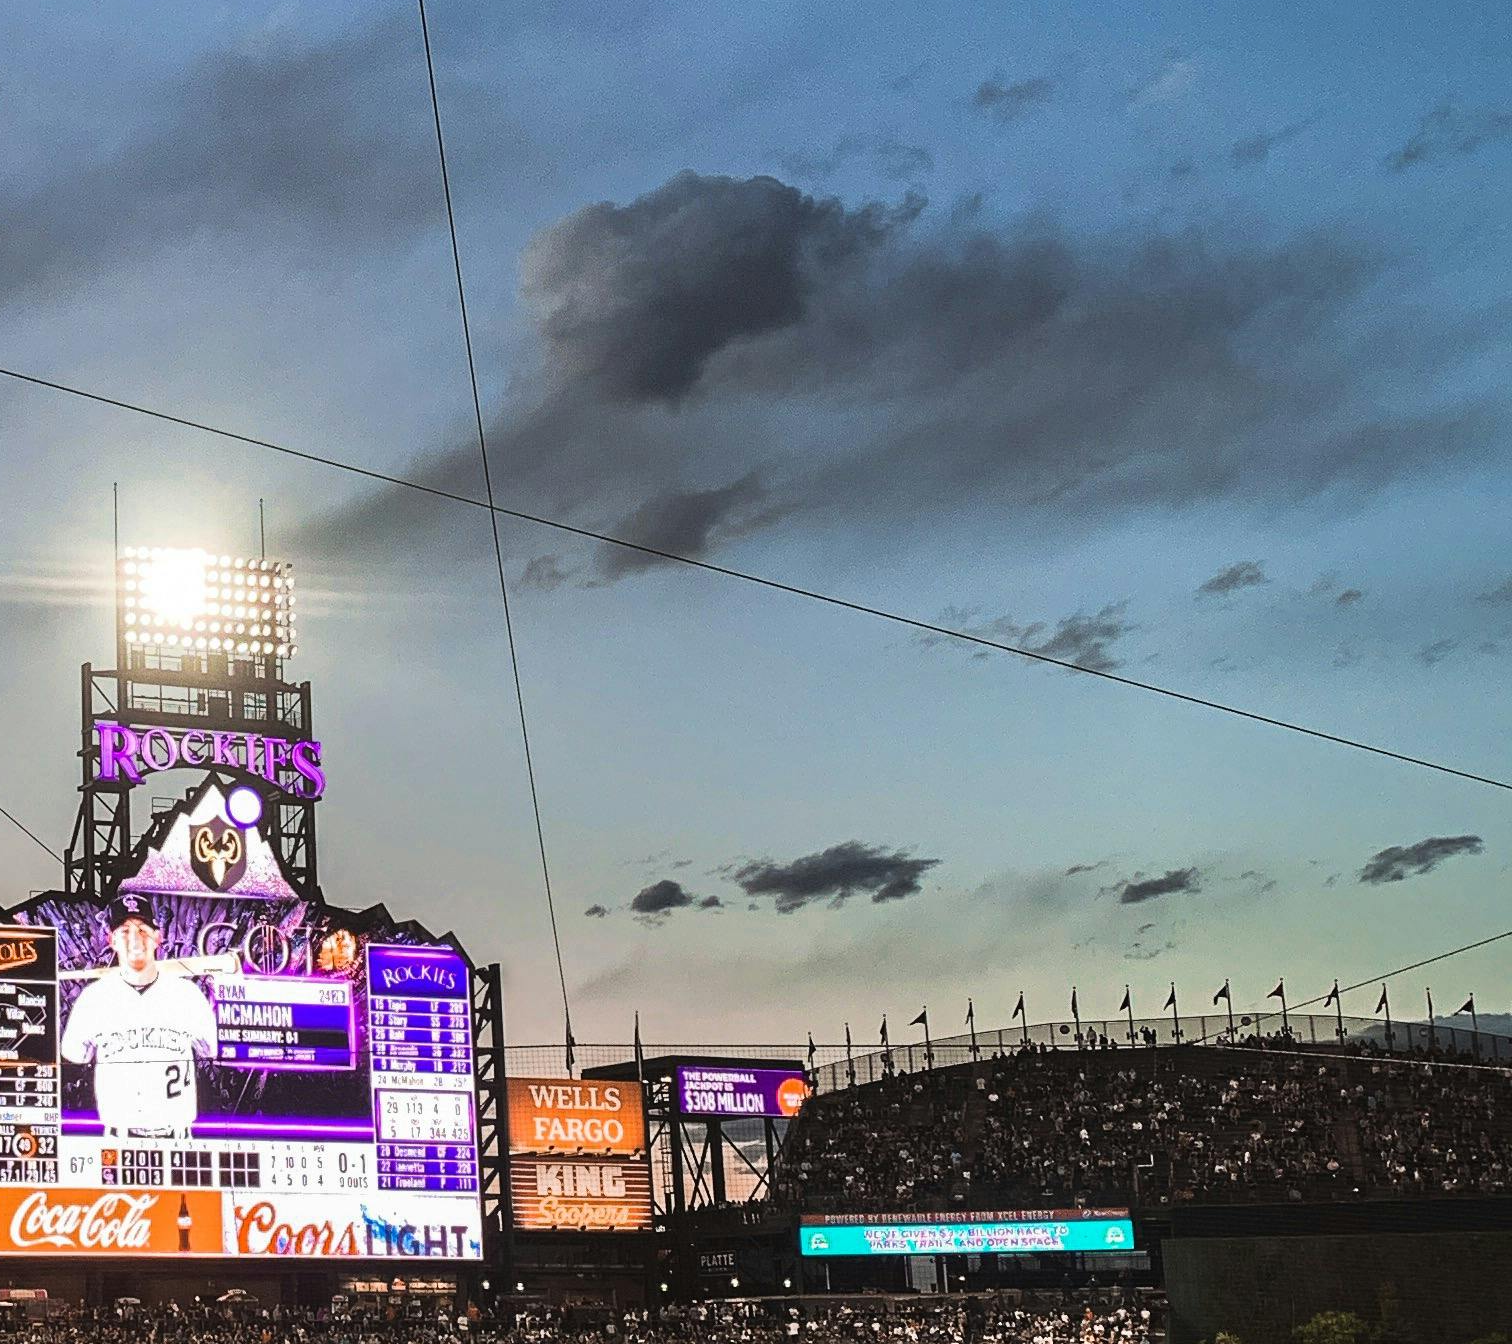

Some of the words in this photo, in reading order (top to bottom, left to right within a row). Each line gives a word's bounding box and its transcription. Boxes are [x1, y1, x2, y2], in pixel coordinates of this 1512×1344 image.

[94, 720, 326, 799] ROCKIES
[382, 964, 457, 990] ROCKIES
[218, 984, 246, 1000] RYAN
[218, 1003, 294, 1028] MCMAHON
[218, 1028, 241, 1043] GAME
[391, 1074, 425, 1086] McMahon
[682, 1070, 701, 1081] THE
[702, 1072, 757, 1084] POWERBALL
[684, 1081, 723, 1092] JACKPOT
[724, 1082, 735, 1092] IS
[528, 1084, 622, 1112] WELLS
[684, 1090, 717, 1113] $308
[717, 1092, 765, 1114] MILLION
[533, 1117, 624, 1144] FARGO
[38, 1136, 55, 1155] 32
[125, 1153, 133, 1167] 2
[172, 1153, 181, 1167] 4
[285, 1157, 295, 1169] 10
[153, 1171, 161, 1185] 3
[536, 1164, 627, 1197] KING
[9, 1190, 160, 1249] Coca-Cola
[537, 1196, 630, 1228] Soopers
[825, 1214, 865, 1225] POWERED
[867, 1214, 879, 1224] BY
[881, 1213, 933, 1224] RENEWABLE
[970, 1211, 994, 1223] FROM
[998, 1210, 1020, 1221] XCEL
[1021, 1209, 1055, 1221] ENERGY
[234, 1201, 361, 1256] Coors
[365, 1223, 468, 1257] LIGHT
[901, 1230, 936, 1239] GIVEN
[968, 1227, 1014, 1238] BILLION
[1052, 1225, 1068, 1235] TO
[959, 1238, 984, 1248] AND
[986, 1237, 1019, 1247] OPEN
[700, 1253, 735, 1267] PLATTE
